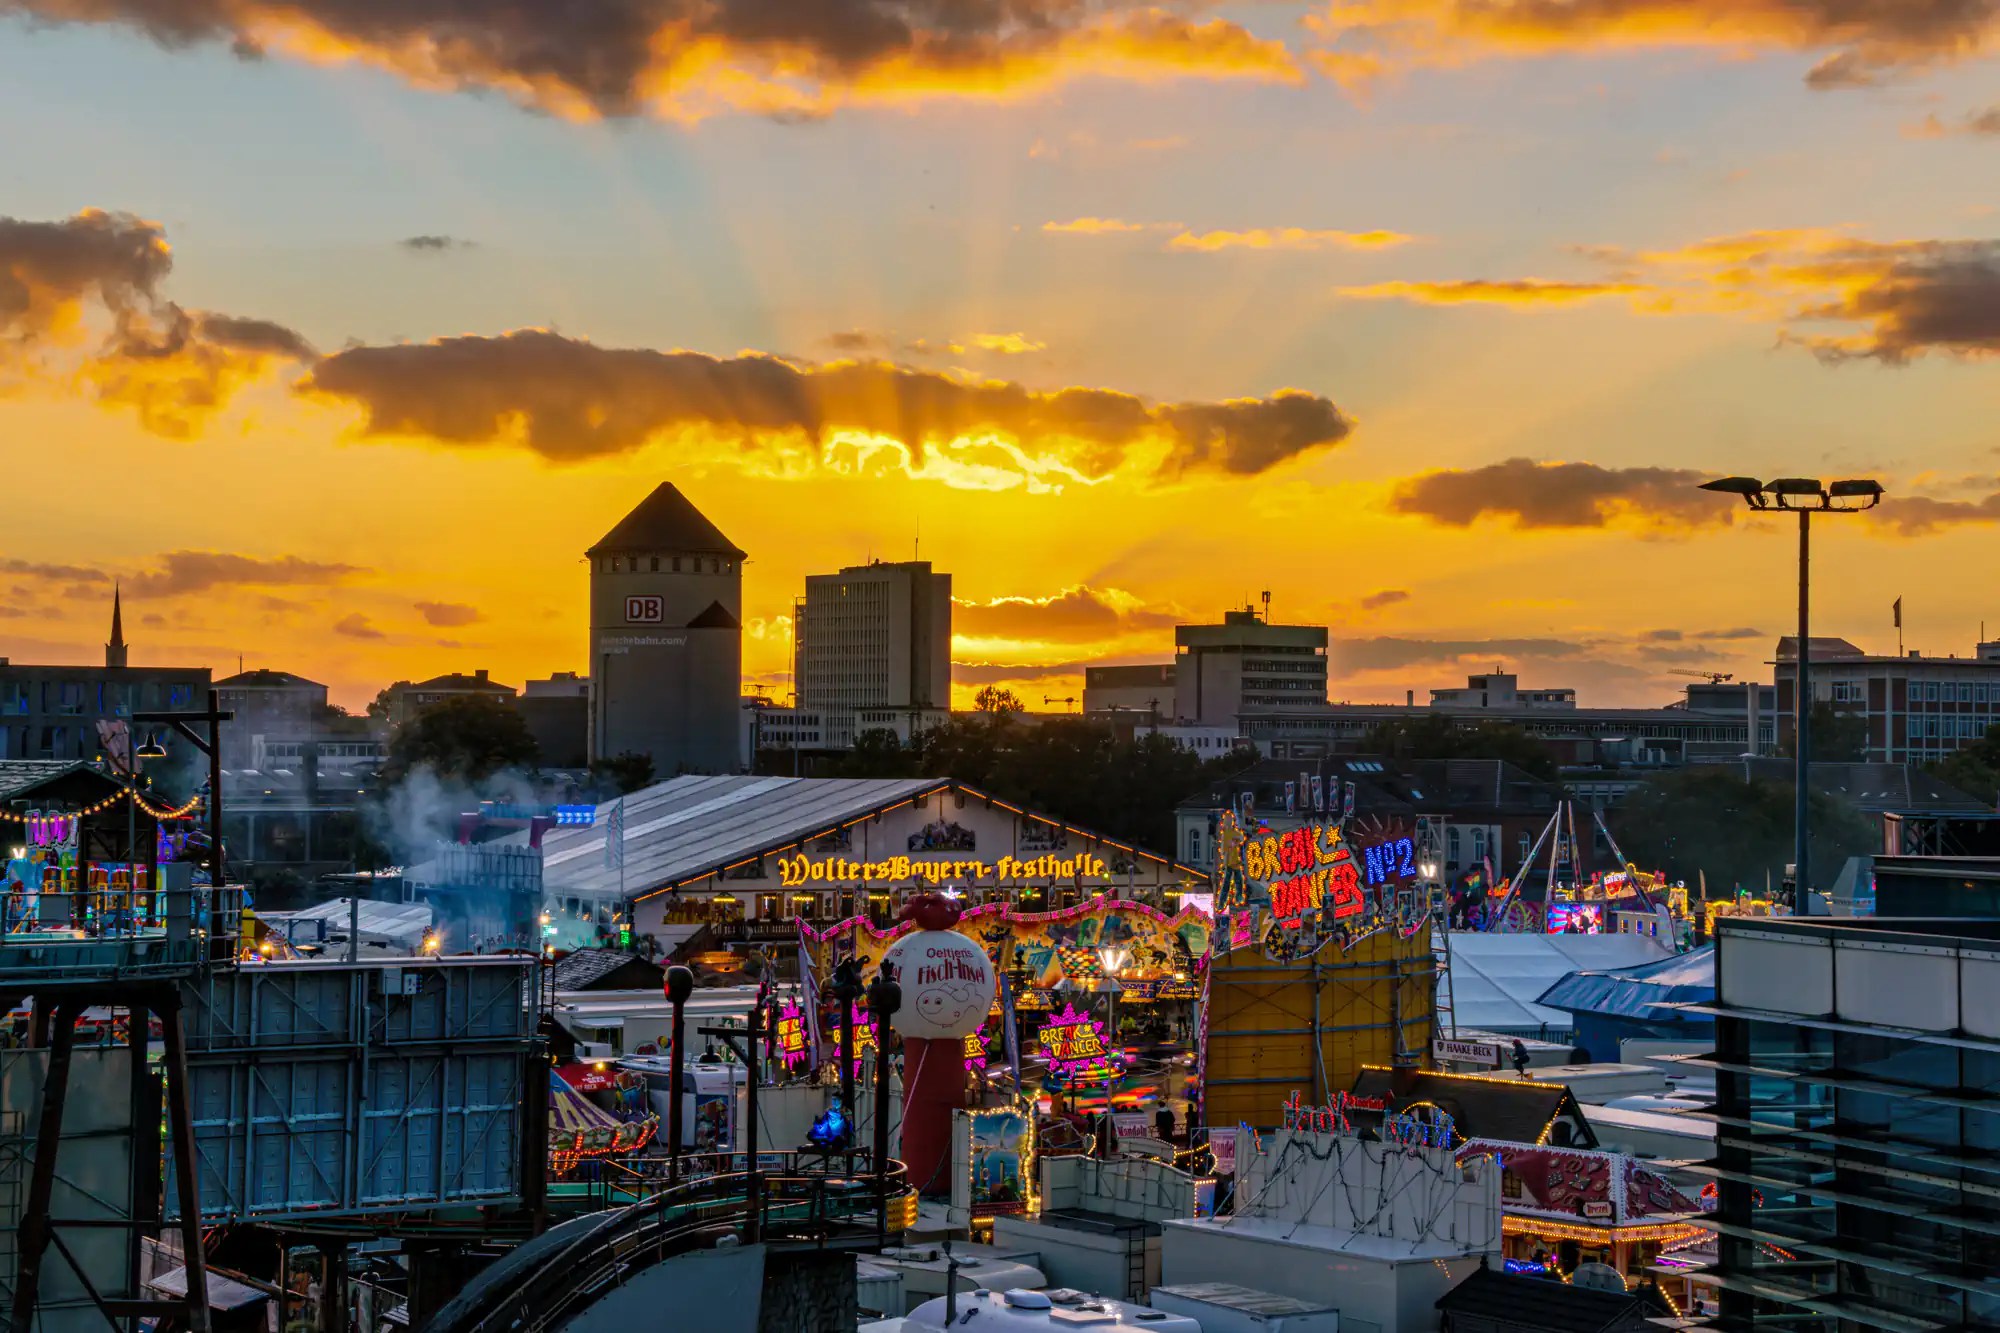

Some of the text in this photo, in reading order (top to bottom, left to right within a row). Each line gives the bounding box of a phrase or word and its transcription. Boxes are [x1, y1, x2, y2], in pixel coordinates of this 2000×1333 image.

[628, 599, 660, 620] DB
[1246, 823, 1350, 882] BREAK
[1268, 863, 1363, 920] DANCER
[1040, 1024, 1095, 1044] BREAK
[1052, 1038, 1104, 1057] DANCER
